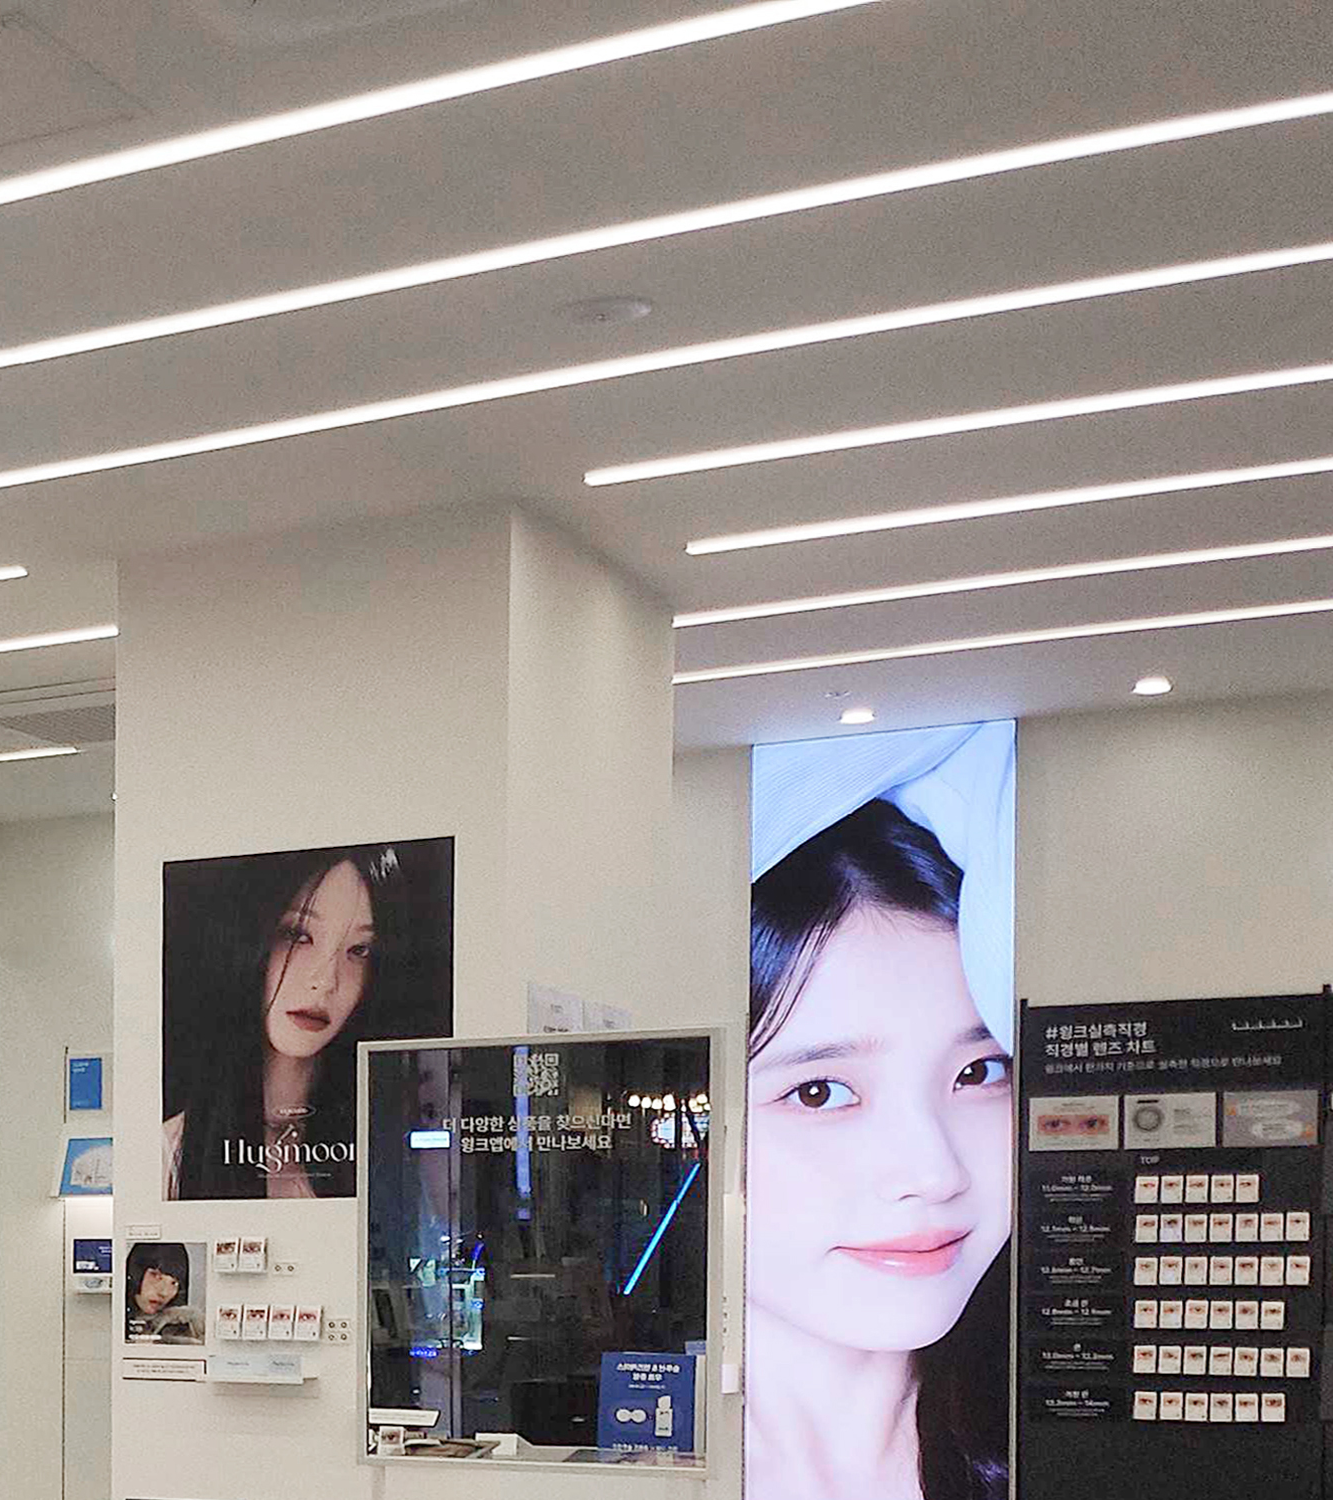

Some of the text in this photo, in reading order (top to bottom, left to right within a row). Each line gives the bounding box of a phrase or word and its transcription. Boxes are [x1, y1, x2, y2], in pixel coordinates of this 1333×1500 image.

[1045, 1022, 1149, 1040] #윙크실측직경
[1045, 1040, 1157, 1057] 직경별 렌즈 차트
[442, 1112, 632, 1134] 더 다양한 상품을 찾으신다면
[460, 1135, 614, 1153] 윙크앱에서 만나보세요
